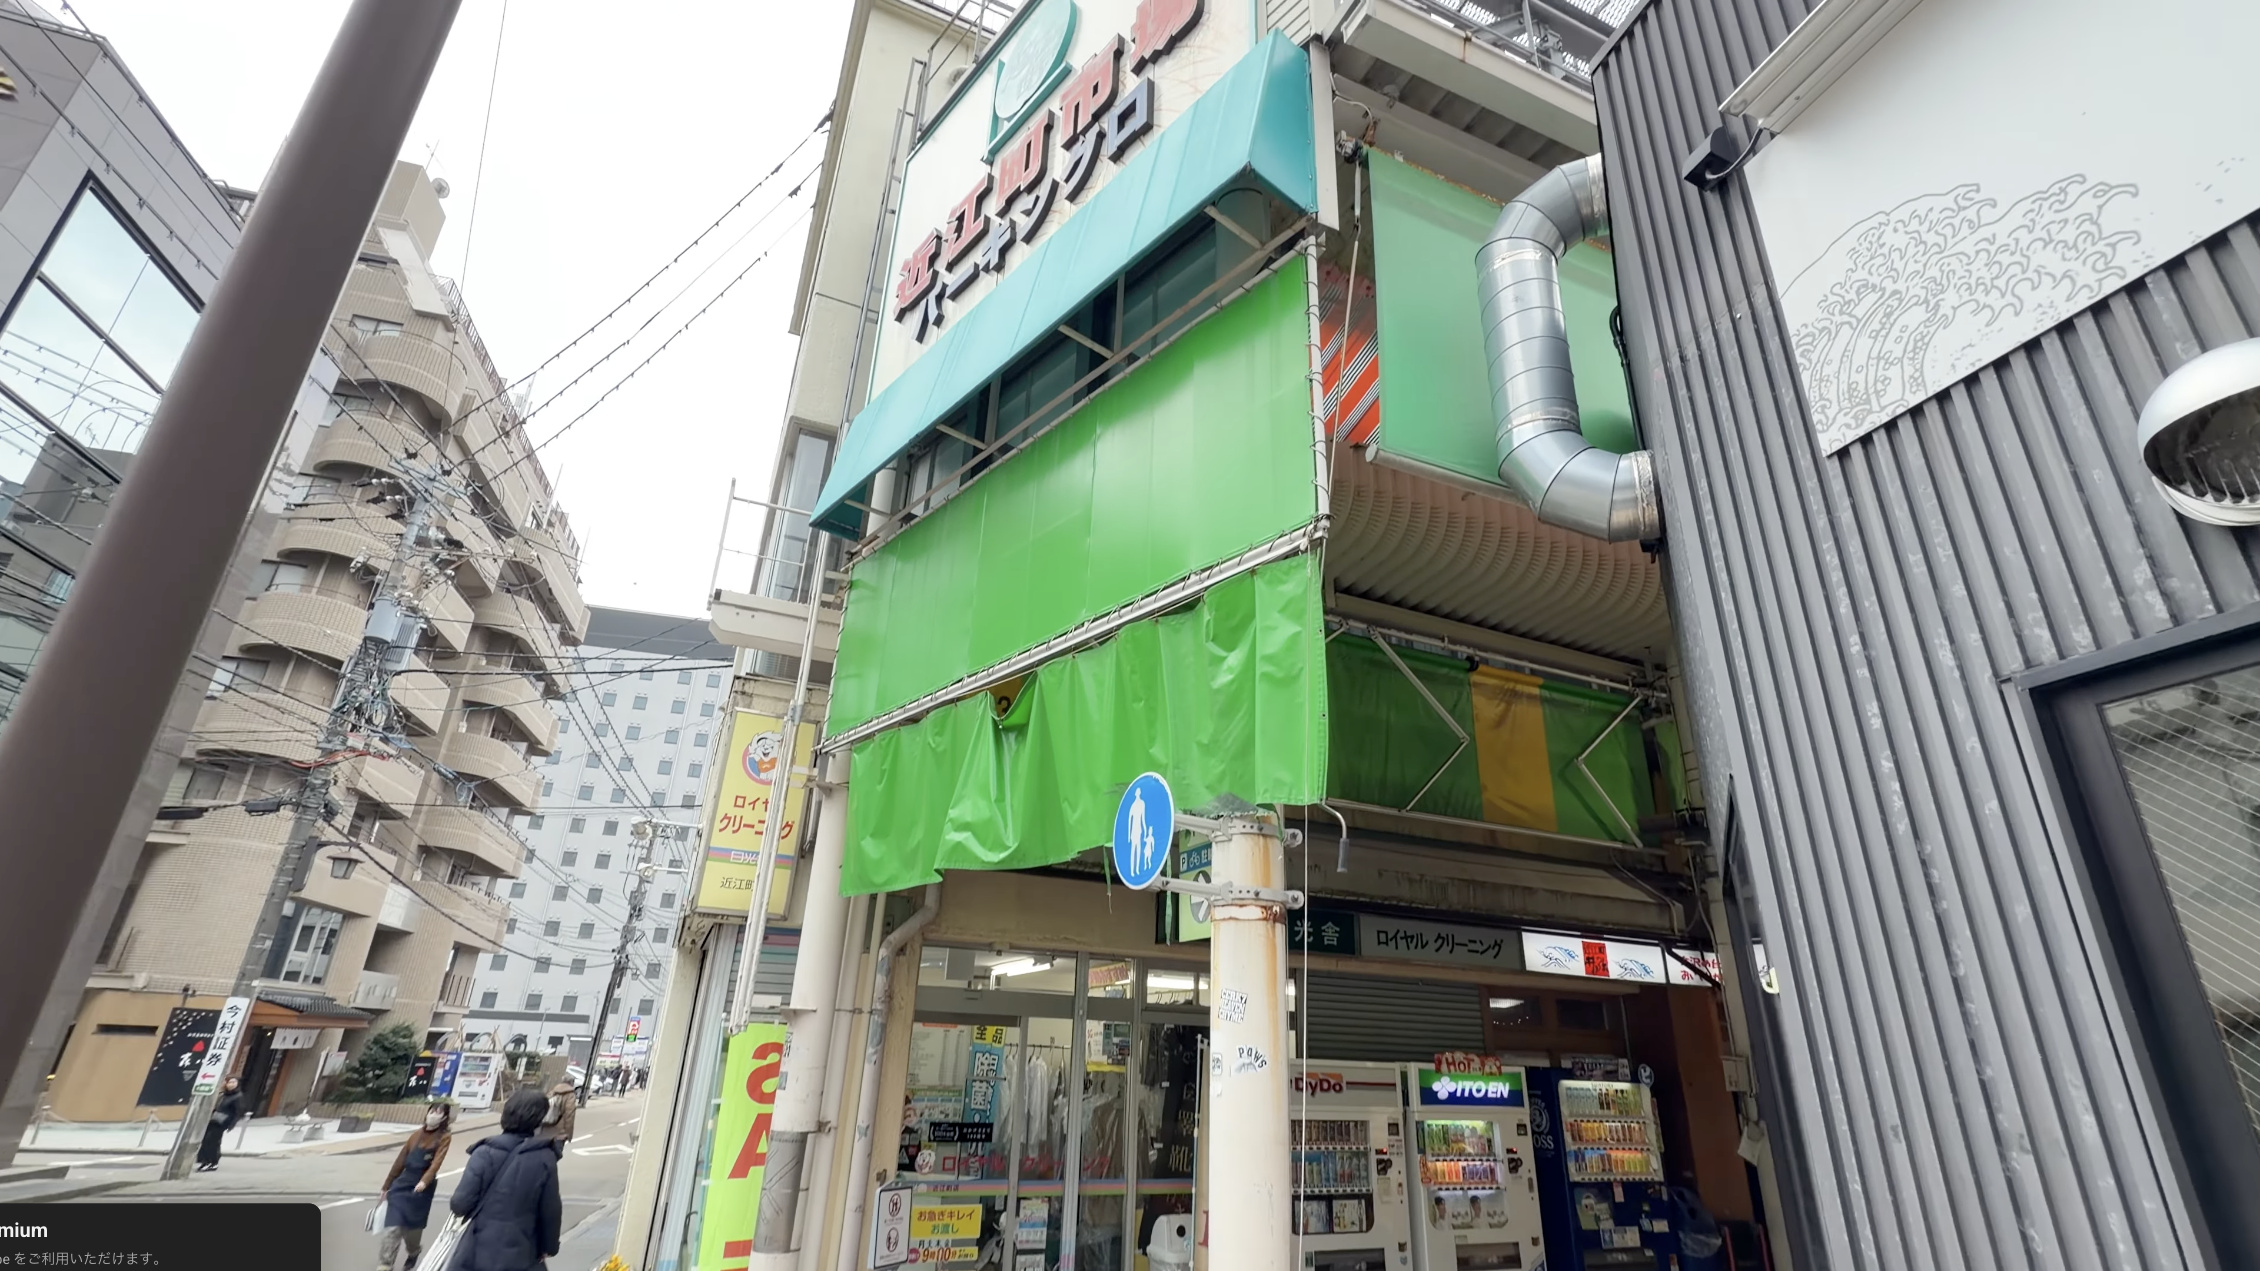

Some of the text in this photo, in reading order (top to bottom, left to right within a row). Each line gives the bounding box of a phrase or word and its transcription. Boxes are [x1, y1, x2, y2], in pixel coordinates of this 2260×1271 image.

[1376, 929, 1504, 960] ロイヤル クリーニング
[205, 1004, 242, 1067] 今村証券
[1294, 1077, 1344, 1098] DyDo
[1456, 1080, 1486, 1098] ITO
[917, 1210, 976, 1223] お急ぎキレイ
[930, 1223, 960, 1235] お渡し
